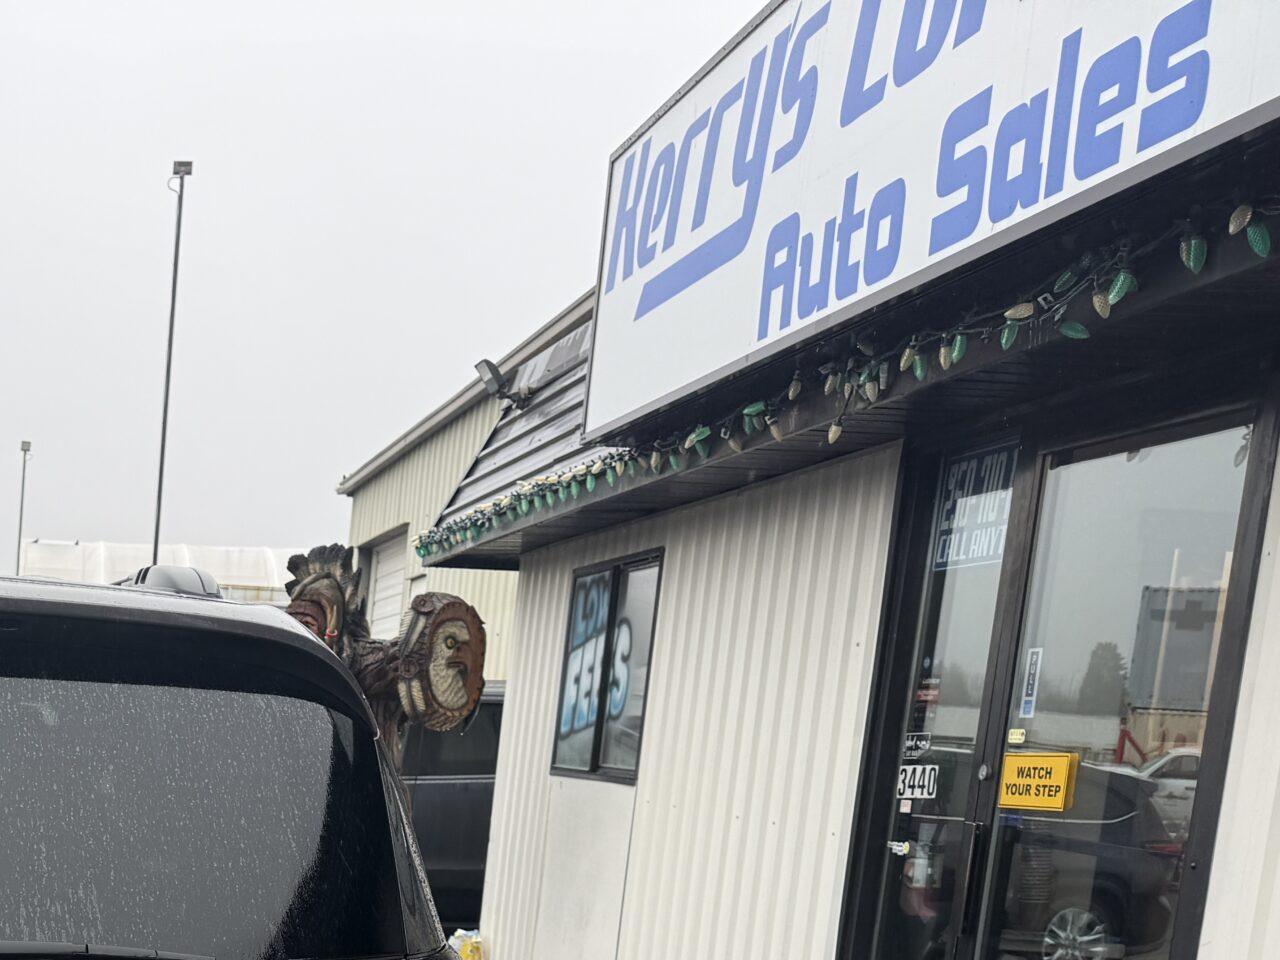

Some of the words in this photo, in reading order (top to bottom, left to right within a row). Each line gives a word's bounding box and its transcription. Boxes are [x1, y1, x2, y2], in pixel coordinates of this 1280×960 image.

[757, 171, 907, 342] Auto
[928, 0, 1212, 257] Sales
[935, 531, 966, 563] CALL
[1027, 654, 1038, 695] PULL
[897, 766, 937, 797] 3440
[1017, 766, 1053, 780] WATCH
[1005, 783, 1032, 797] YOUR
[1034, 783, 1062, 798] STEP
